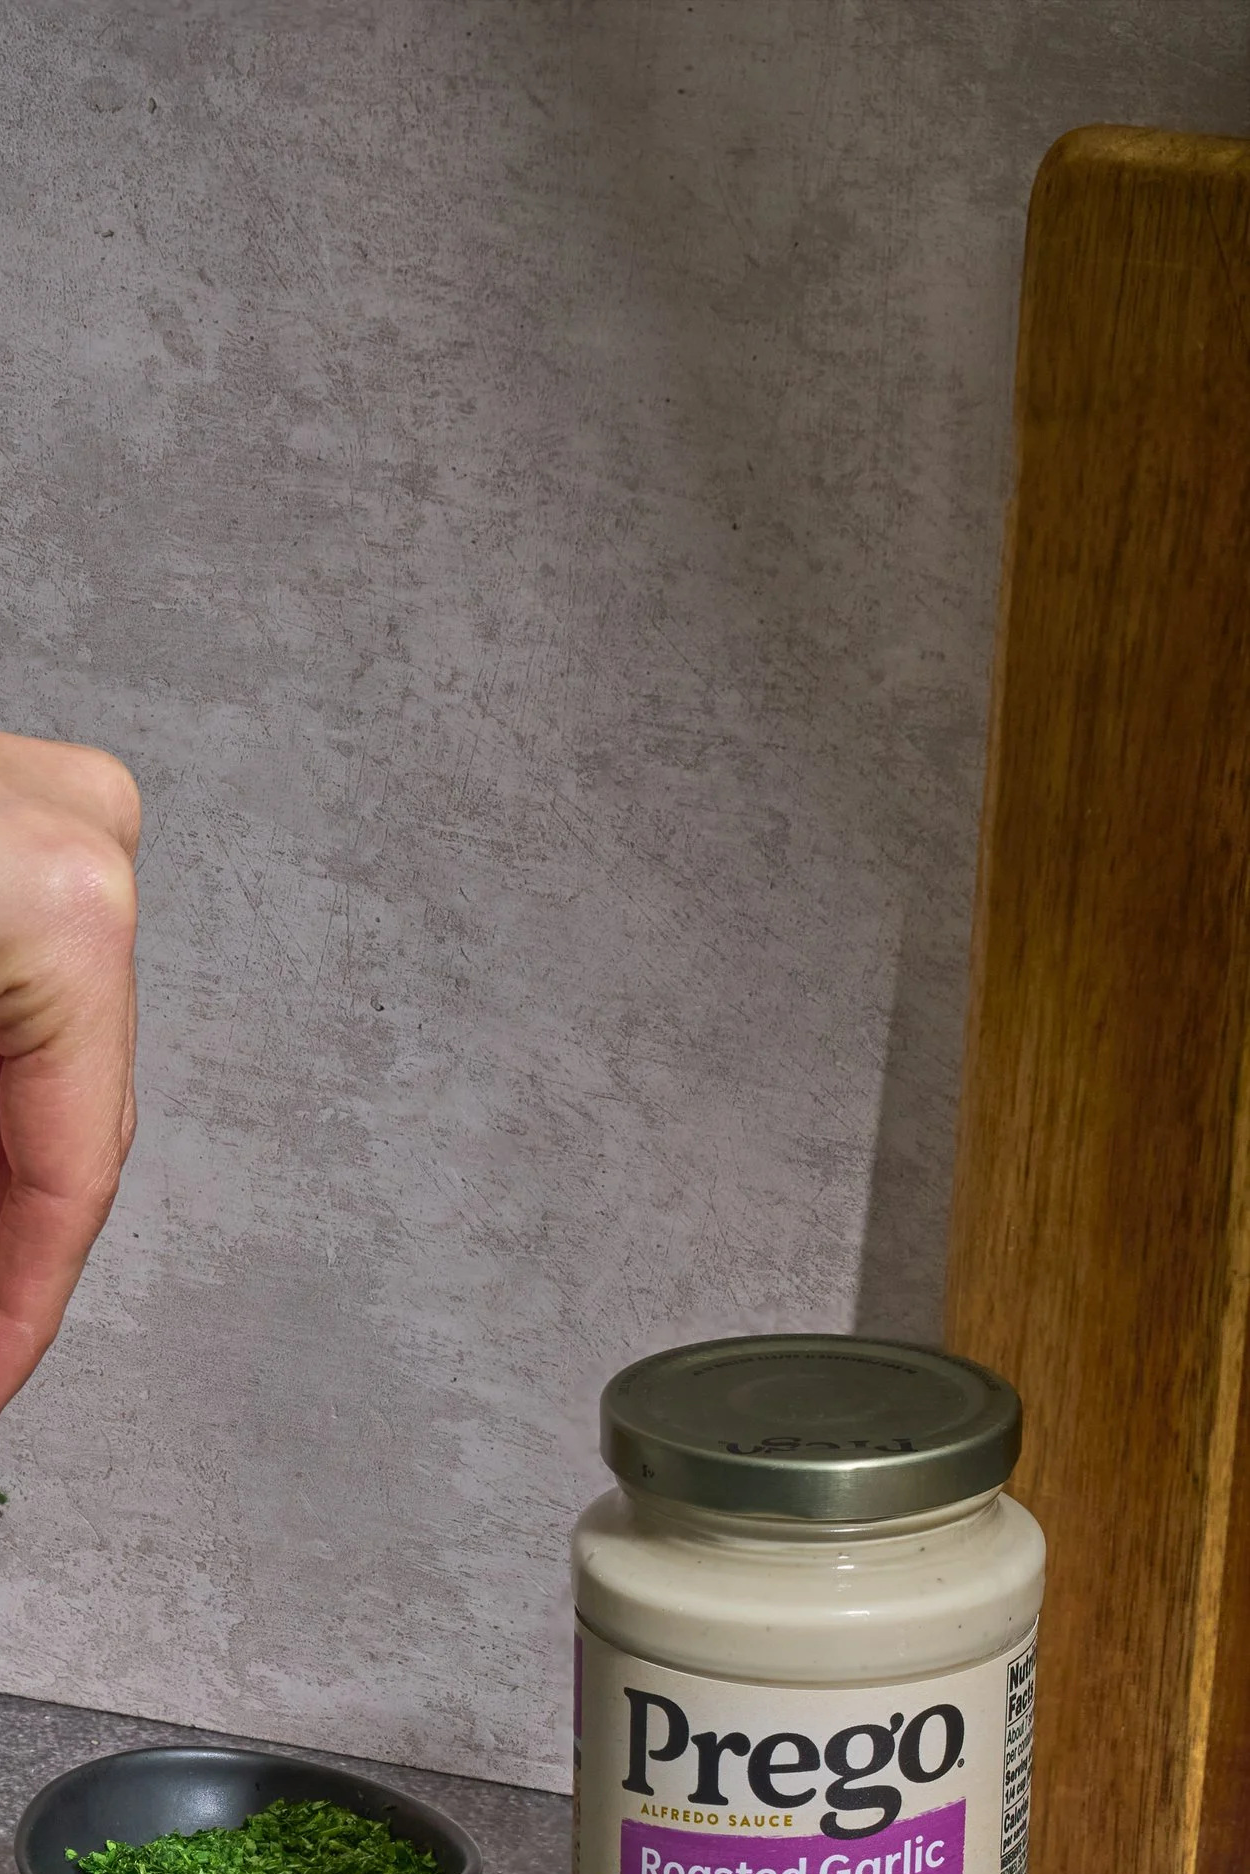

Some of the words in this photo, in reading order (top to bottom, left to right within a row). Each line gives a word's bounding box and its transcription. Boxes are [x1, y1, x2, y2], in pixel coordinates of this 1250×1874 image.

[621, 1686, 965, 1840] Prego
[1006, 1745, 1018, 1770] per
[1005, 1784, 1016, 1806] 1/4
[641, 1803, 719, 1825] ALFREDO
[728, 1814, 793, 1828] SAUCE
